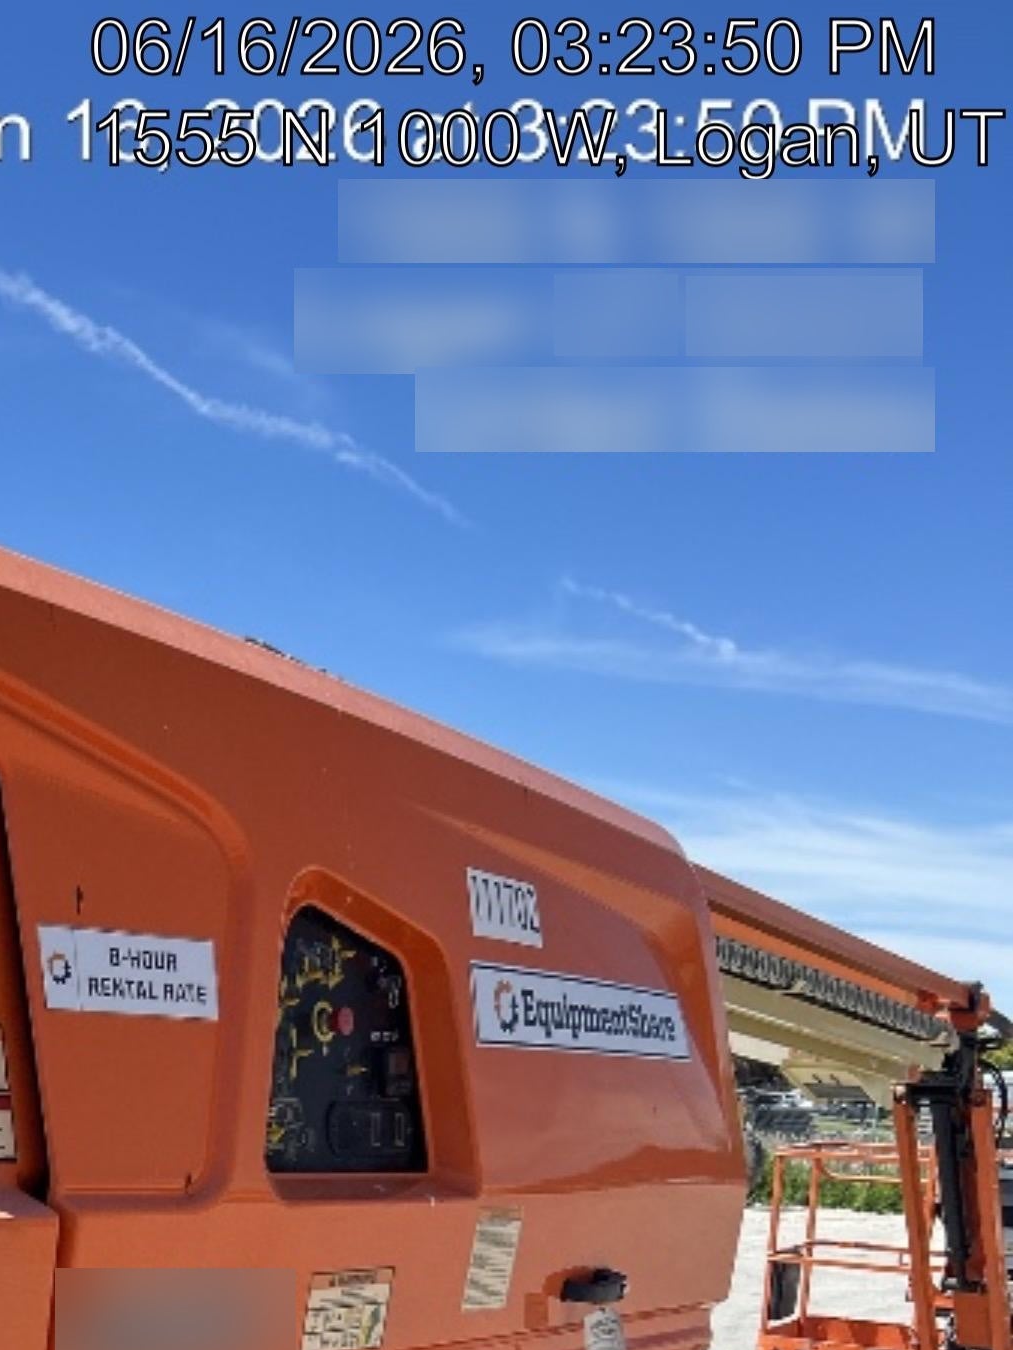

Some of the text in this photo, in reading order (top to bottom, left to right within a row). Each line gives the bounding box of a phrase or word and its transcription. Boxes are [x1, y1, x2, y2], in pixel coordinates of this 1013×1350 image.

[109, 947, 178, 972] 8-HOUR
[88, 977, 207, 1006] RENTAL RATE
[520, 988, 677, 1041] EquipmentShare
